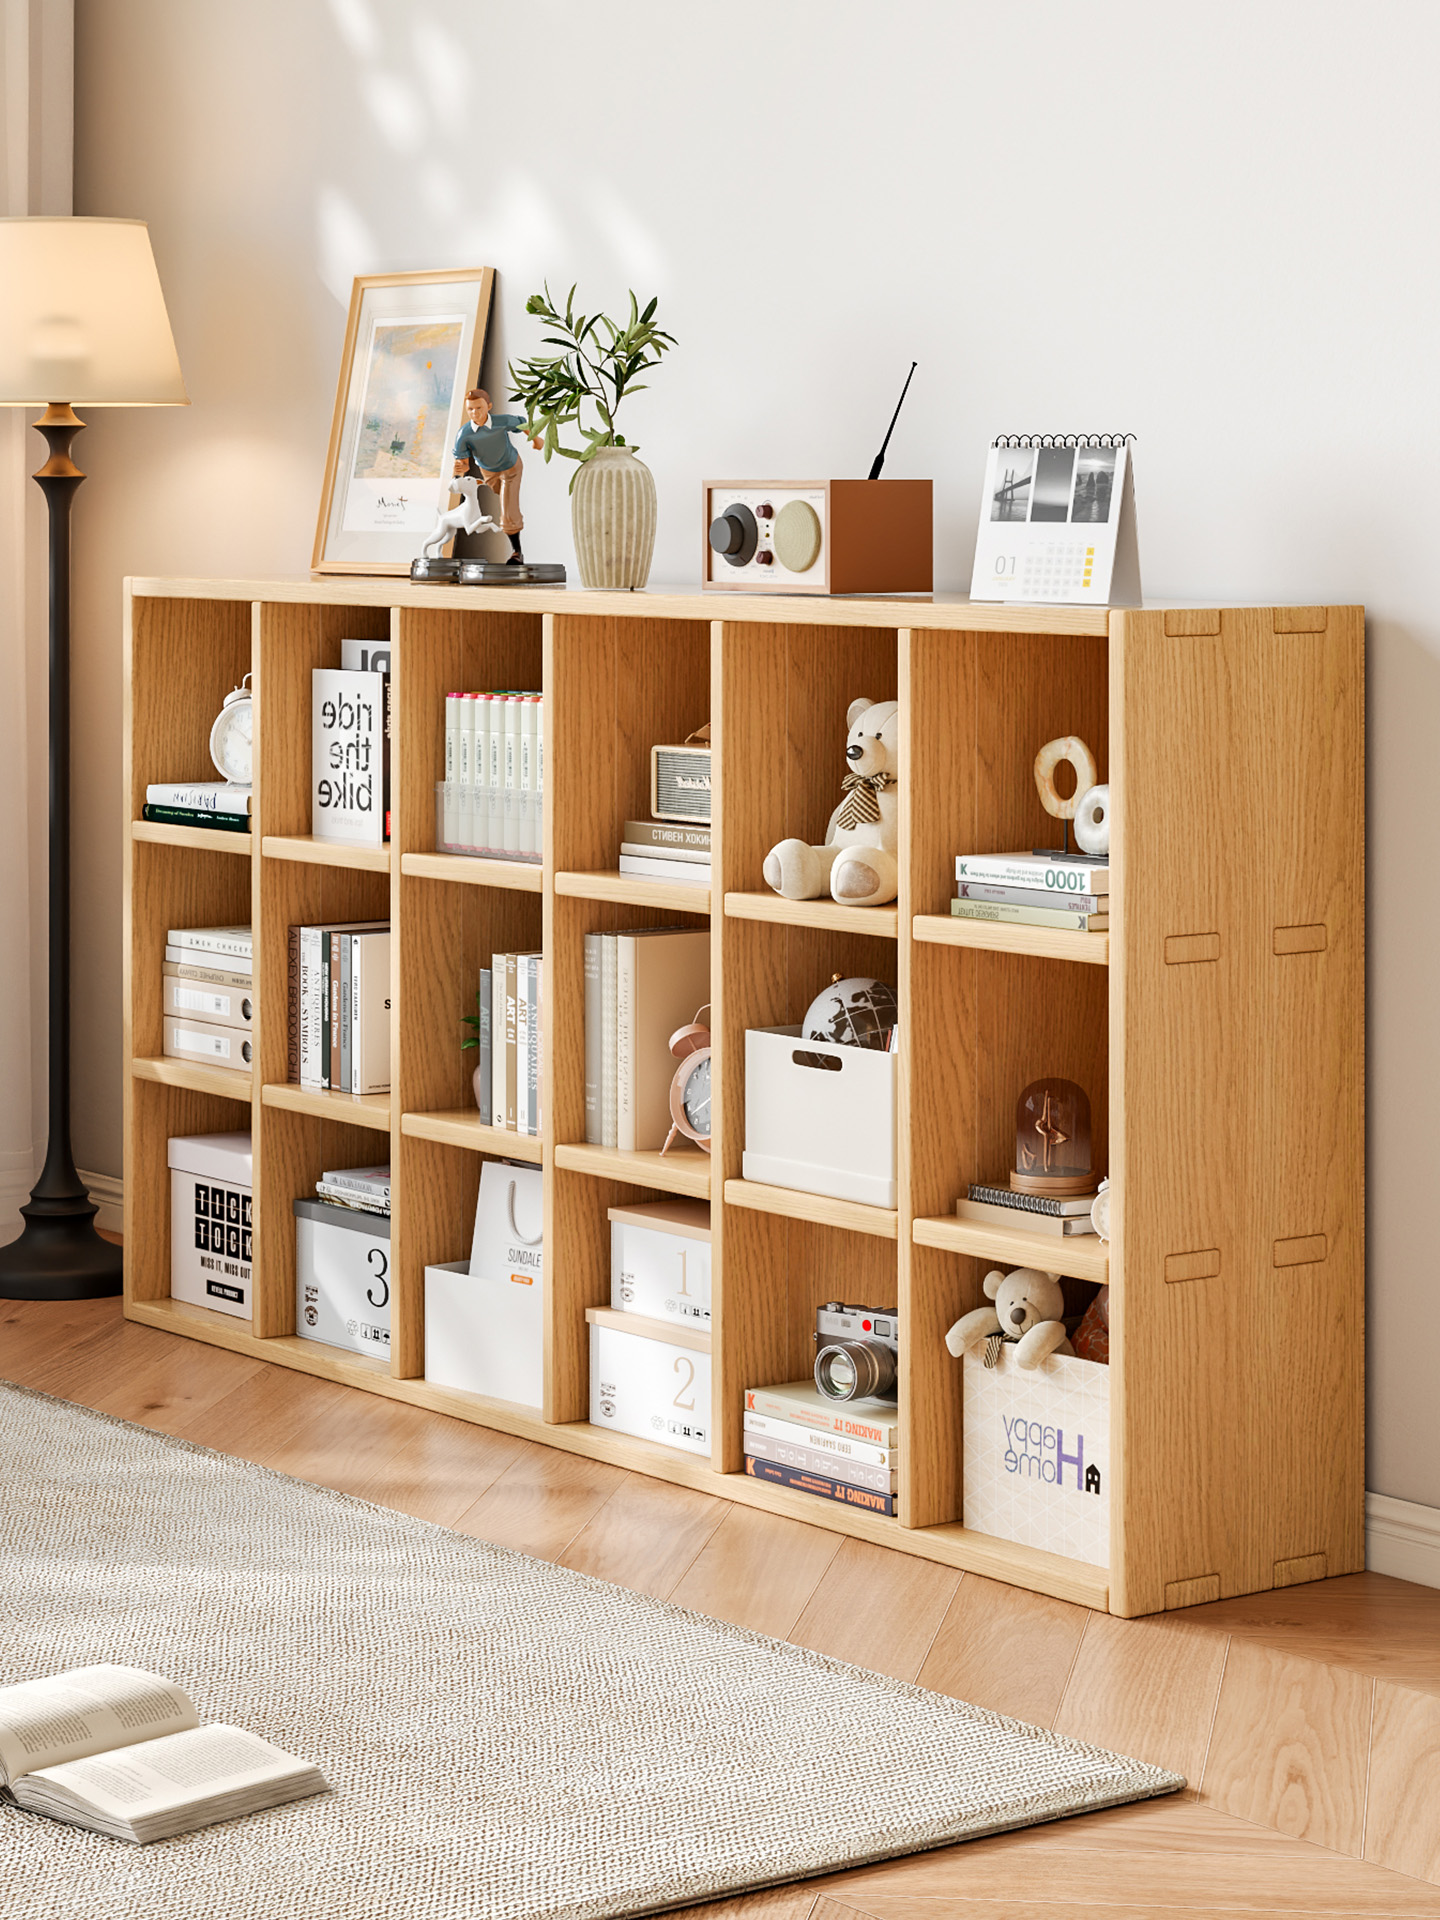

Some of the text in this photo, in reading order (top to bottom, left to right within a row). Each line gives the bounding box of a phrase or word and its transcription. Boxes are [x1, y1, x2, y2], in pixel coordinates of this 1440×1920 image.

[995, 556, 1017, 575] 01
[652, 829, 684, 843] СТИВЕН
[1045, 869, 1086, 891] 1000
[288, 930, 298, 982] ALEXEY
[301, 965, 309, 997] BOOK
[506, 996, 516, 1024] ART
[519, 998, 527, 1026] ART
[301, 1008, 309, 1064] SYMBOLS
[199, 1190, 252, 1223] TICK
[199, 1223, 252, 1256] TOCK
[200, 1256, 214, 1270] MISS
[224, 1262, 239, 1276] MISS
[240, 1266, 251, 1280] OUT
[507, 1248, 542, 1268] SUNDALE
[367, 1248, 389, 1308] 3
[677, 1249, 691, 1298] 1
[673, 1356, 696, 1412] 2
[747, 1393, 755, 1410] K
[833, 1418, 843, 1433] IT
[845, 1421, 882, 1442] MAKING
[746, 1457, 756, 1476] K
[834, 1484, 845, 1499] IT
[846, 1488, 886, 1511] MAKING
